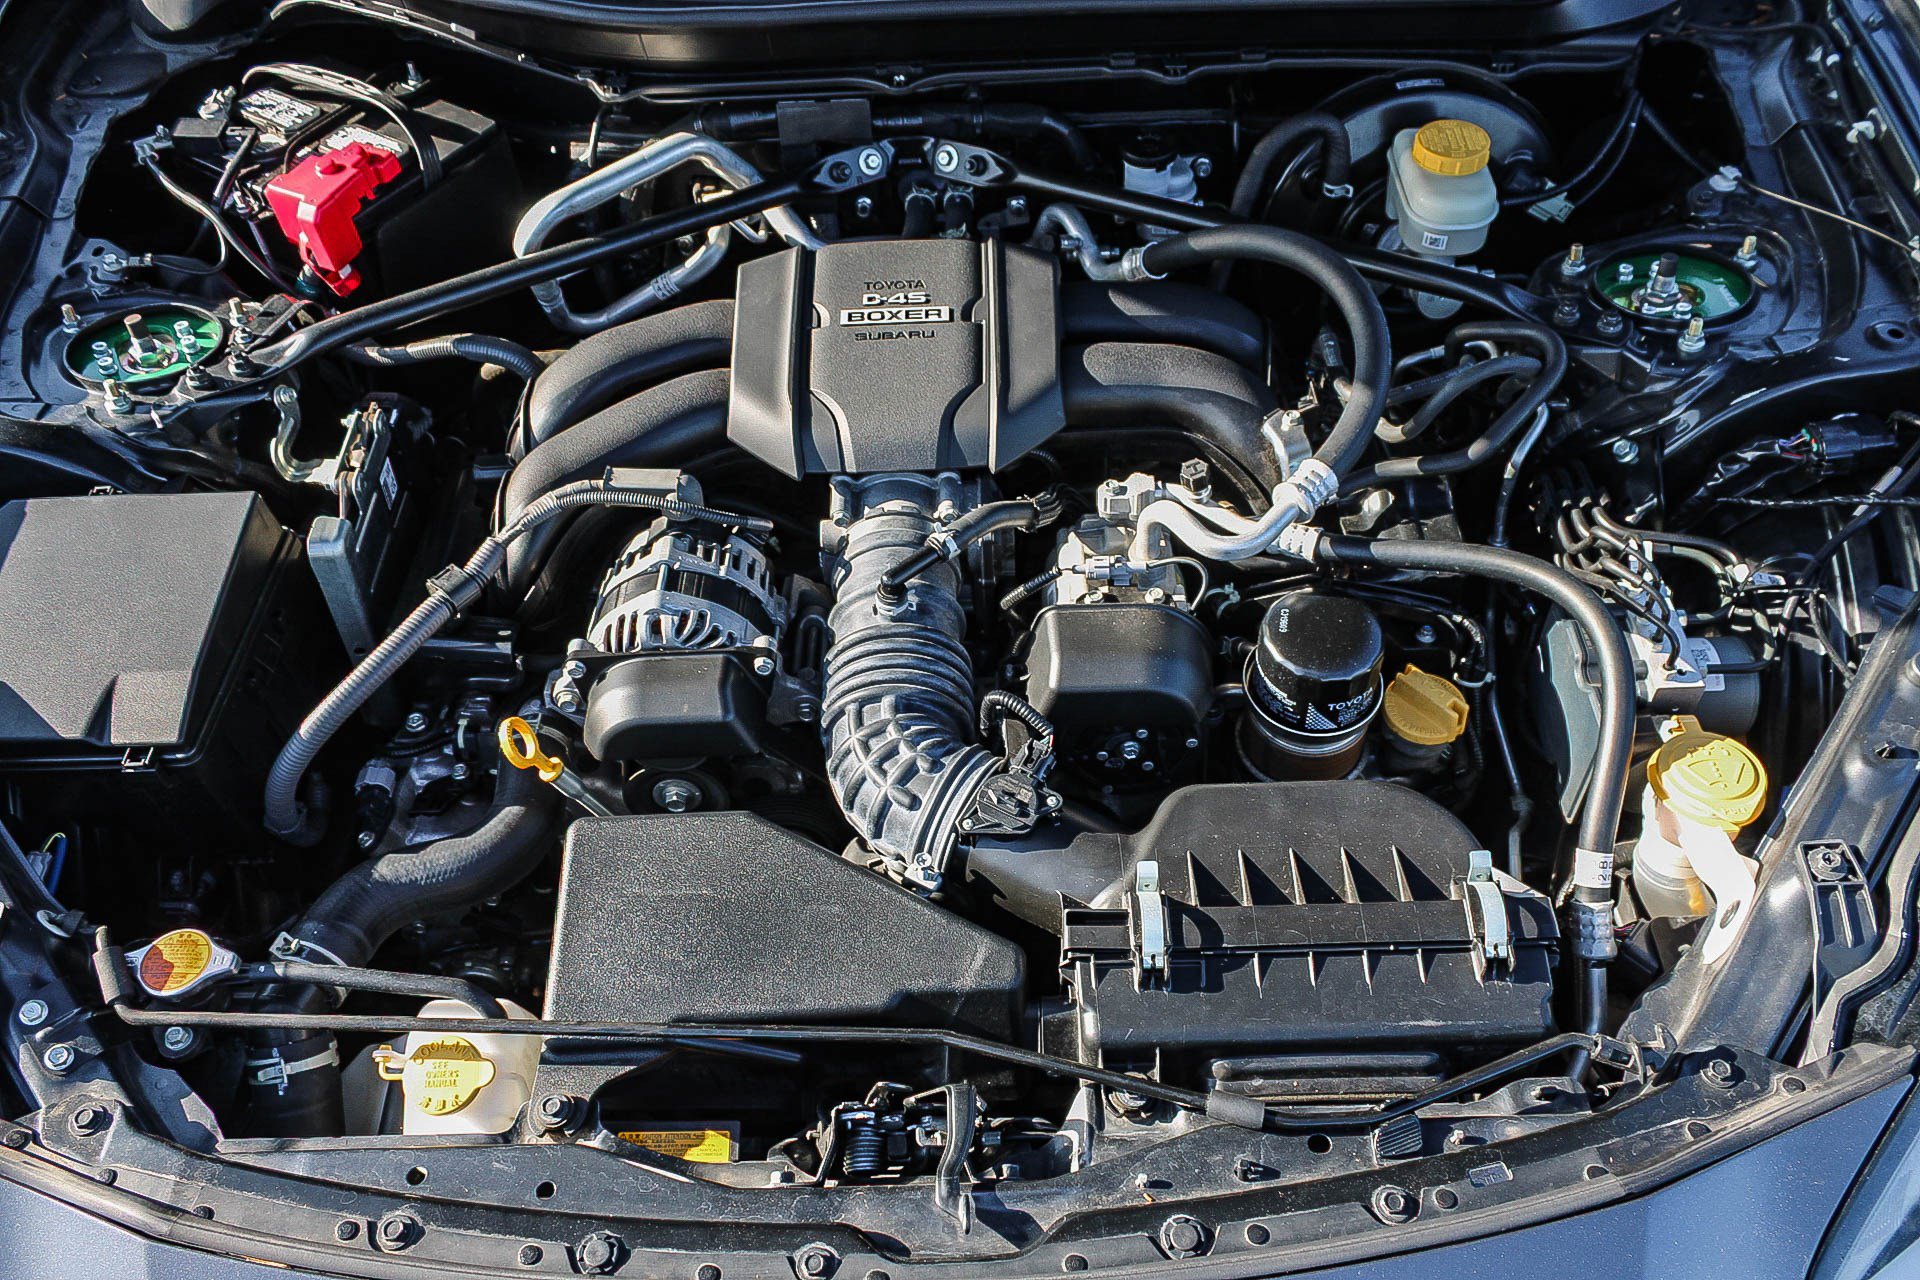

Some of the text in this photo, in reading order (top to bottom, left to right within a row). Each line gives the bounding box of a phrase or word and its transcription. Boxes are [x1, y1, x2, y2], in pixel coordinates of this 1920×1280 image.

[863, 279, 926, 291] TOYOTA
[862, 291, 930, 306] D-4S
[847, 309, 942, 322] BOXER
[855, 330, 936, 341] SUBARU
[1327, 687, 1374, 711] TOYOTA
